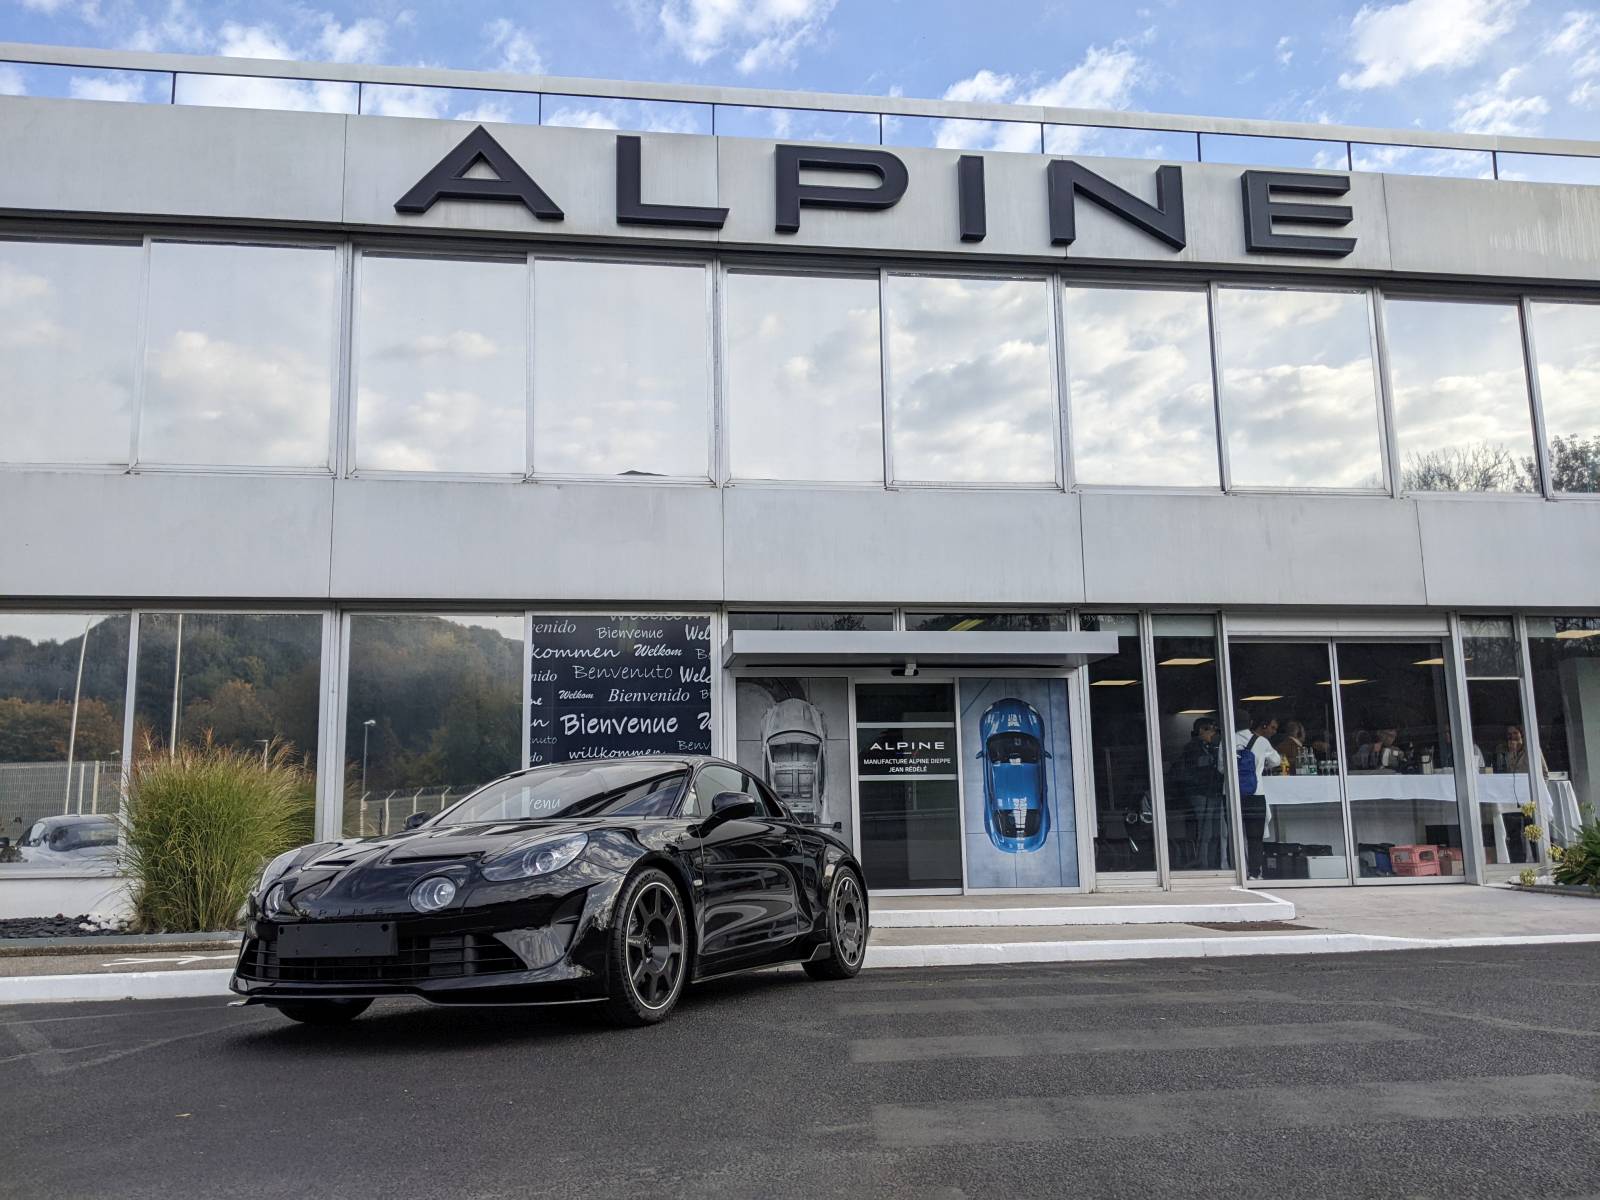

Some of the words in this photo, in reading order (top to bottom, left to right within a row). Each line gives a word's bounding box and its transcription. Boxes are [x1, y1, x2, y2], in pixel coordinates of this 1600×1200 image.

[394, 124, 1358, 260] ALPINE
[596, 626, 664, 639] Bienvenue
[632, 643, 683, 657] Welkom
[572, 664, 673, 680] Benvenuto
[558, 689, 595, 700] Welkom
[607, 687, 690, 702] Bienvenido
[559, 713, 679, 736] Bienvenue
[568, 746, 666, 760] willkommen
[870, 741, 945, 751] ALPINE
